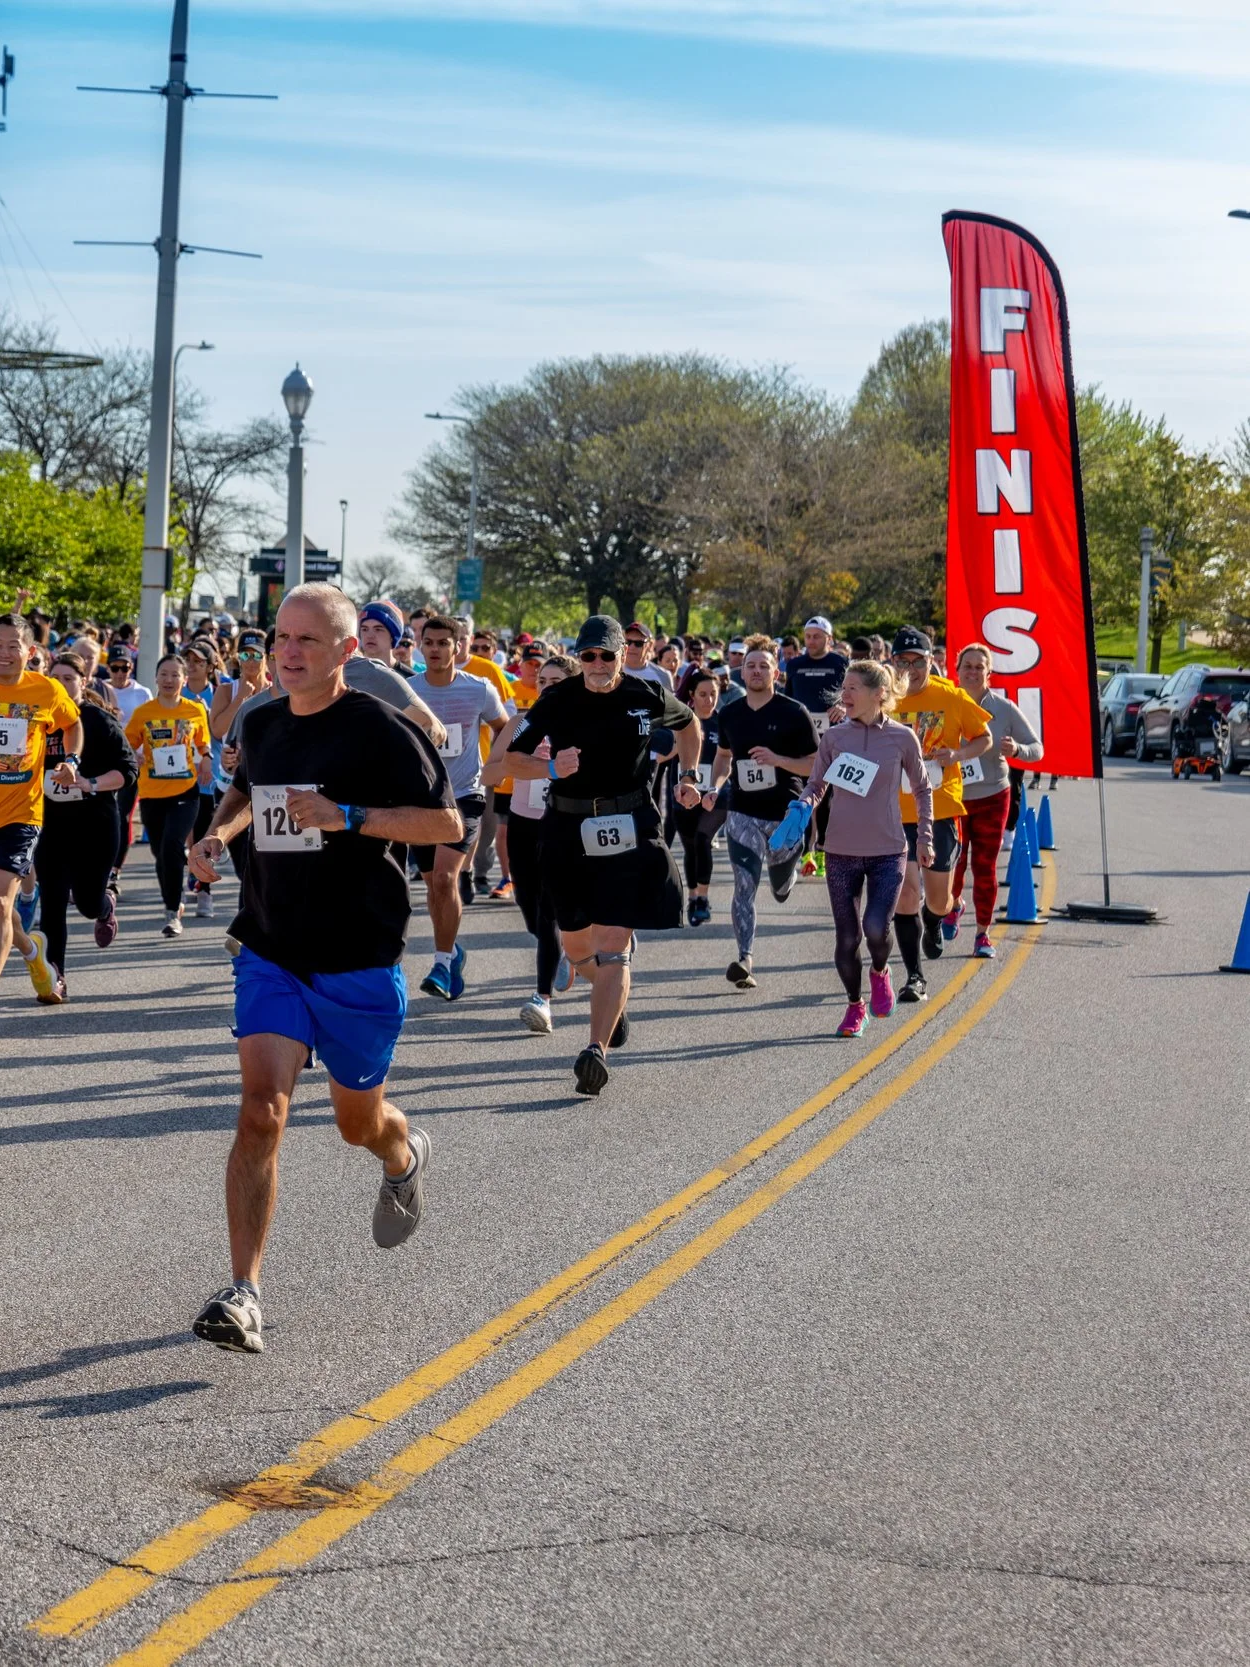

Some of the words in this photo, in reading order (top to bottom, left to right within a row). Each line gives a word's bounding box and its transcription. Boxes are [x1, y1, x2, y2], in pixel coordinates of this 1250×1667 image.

[167, 754, 175, 767] 4
[747, 768, 764, 784] 54
[837, 763, 865, 786] 162
[596, 827, 621, 847] 63
